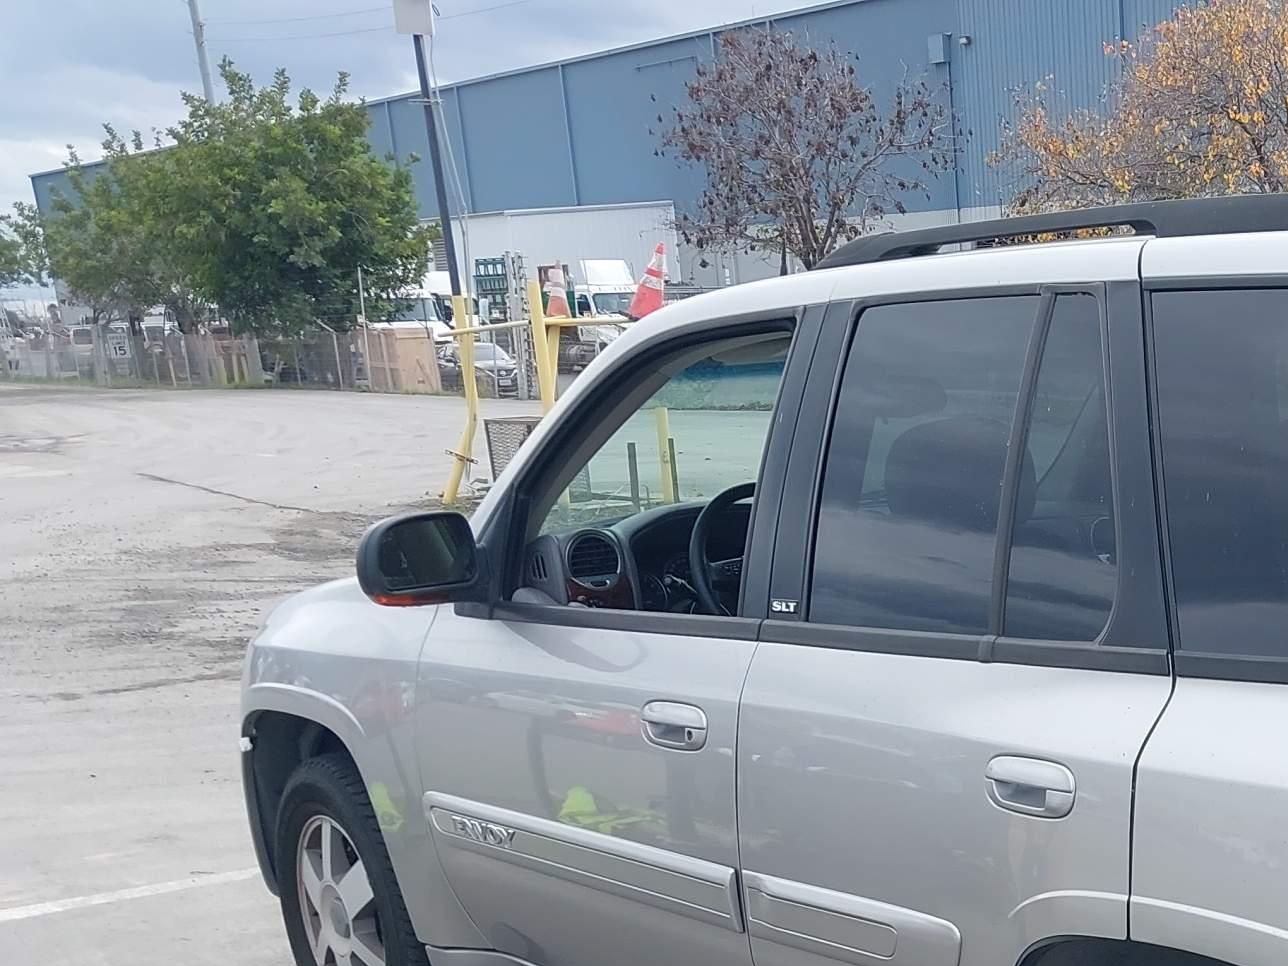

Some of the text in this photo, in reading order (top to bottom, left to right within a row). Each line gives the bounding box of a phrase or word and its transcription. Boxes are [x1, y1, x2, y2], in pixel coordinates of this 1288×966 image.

[113, 346, 127, 356] 15
[771, 601, 797, 612] SLT
[451, 815, 516, 848] ENVOY
